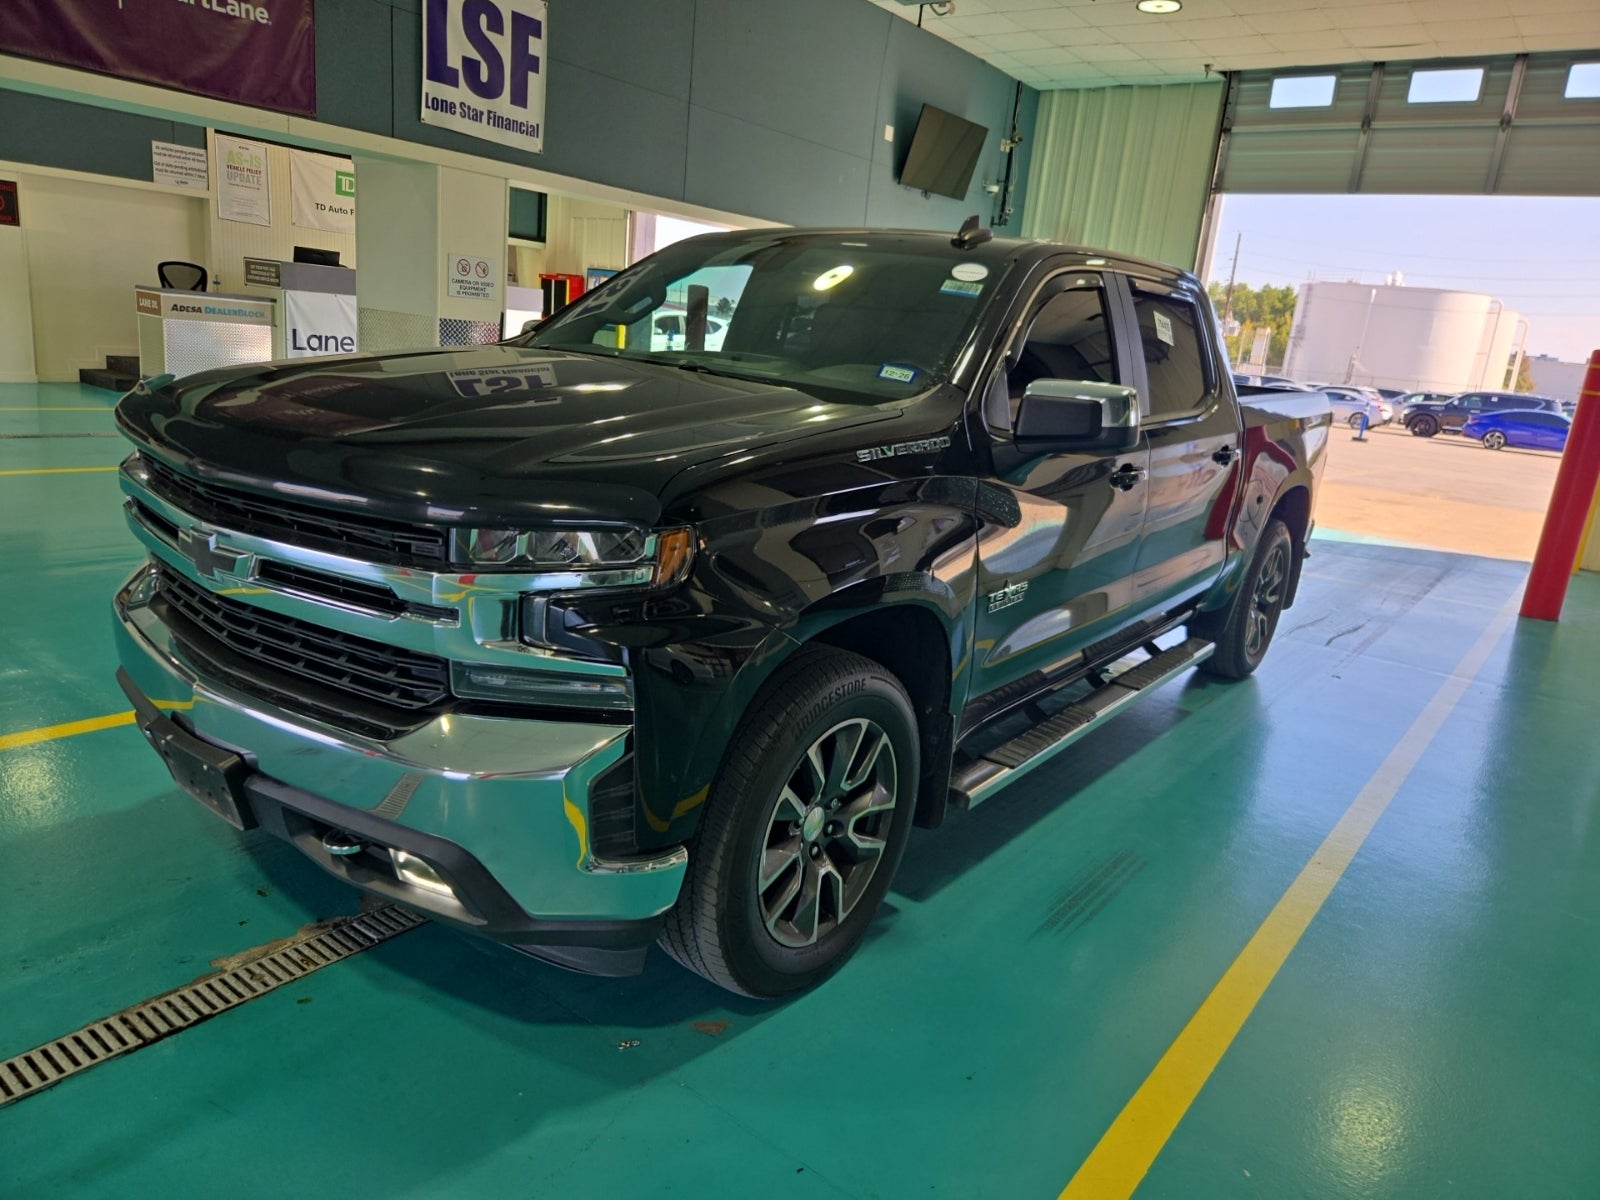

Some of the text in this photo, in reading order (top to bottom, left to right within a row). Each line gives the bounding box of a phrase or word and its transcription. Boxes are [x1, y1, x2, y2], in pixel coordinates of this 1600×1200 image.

[426, 0, 542, 109] LSF
[425, 92, 539, 138] Lone Star Financial
[226, 150, 261, 168] AS-IS
[226, 164, 261, 175] VEHICLE POLICY
[226, 171, 262, 185] UPDATE
[338, 175, 354, 192] TD
[315, 202, 326, 211] TD
[329, 205, 348, 215] Auto
[451, 278, 471, 286] CAMERA
[171, 303, 202, 314] ADESA
[292, 328, 355, 352] Lane
[856, 436, 951, 463] SILVERADO
[988, 581, 1028, 603] TEXAS
